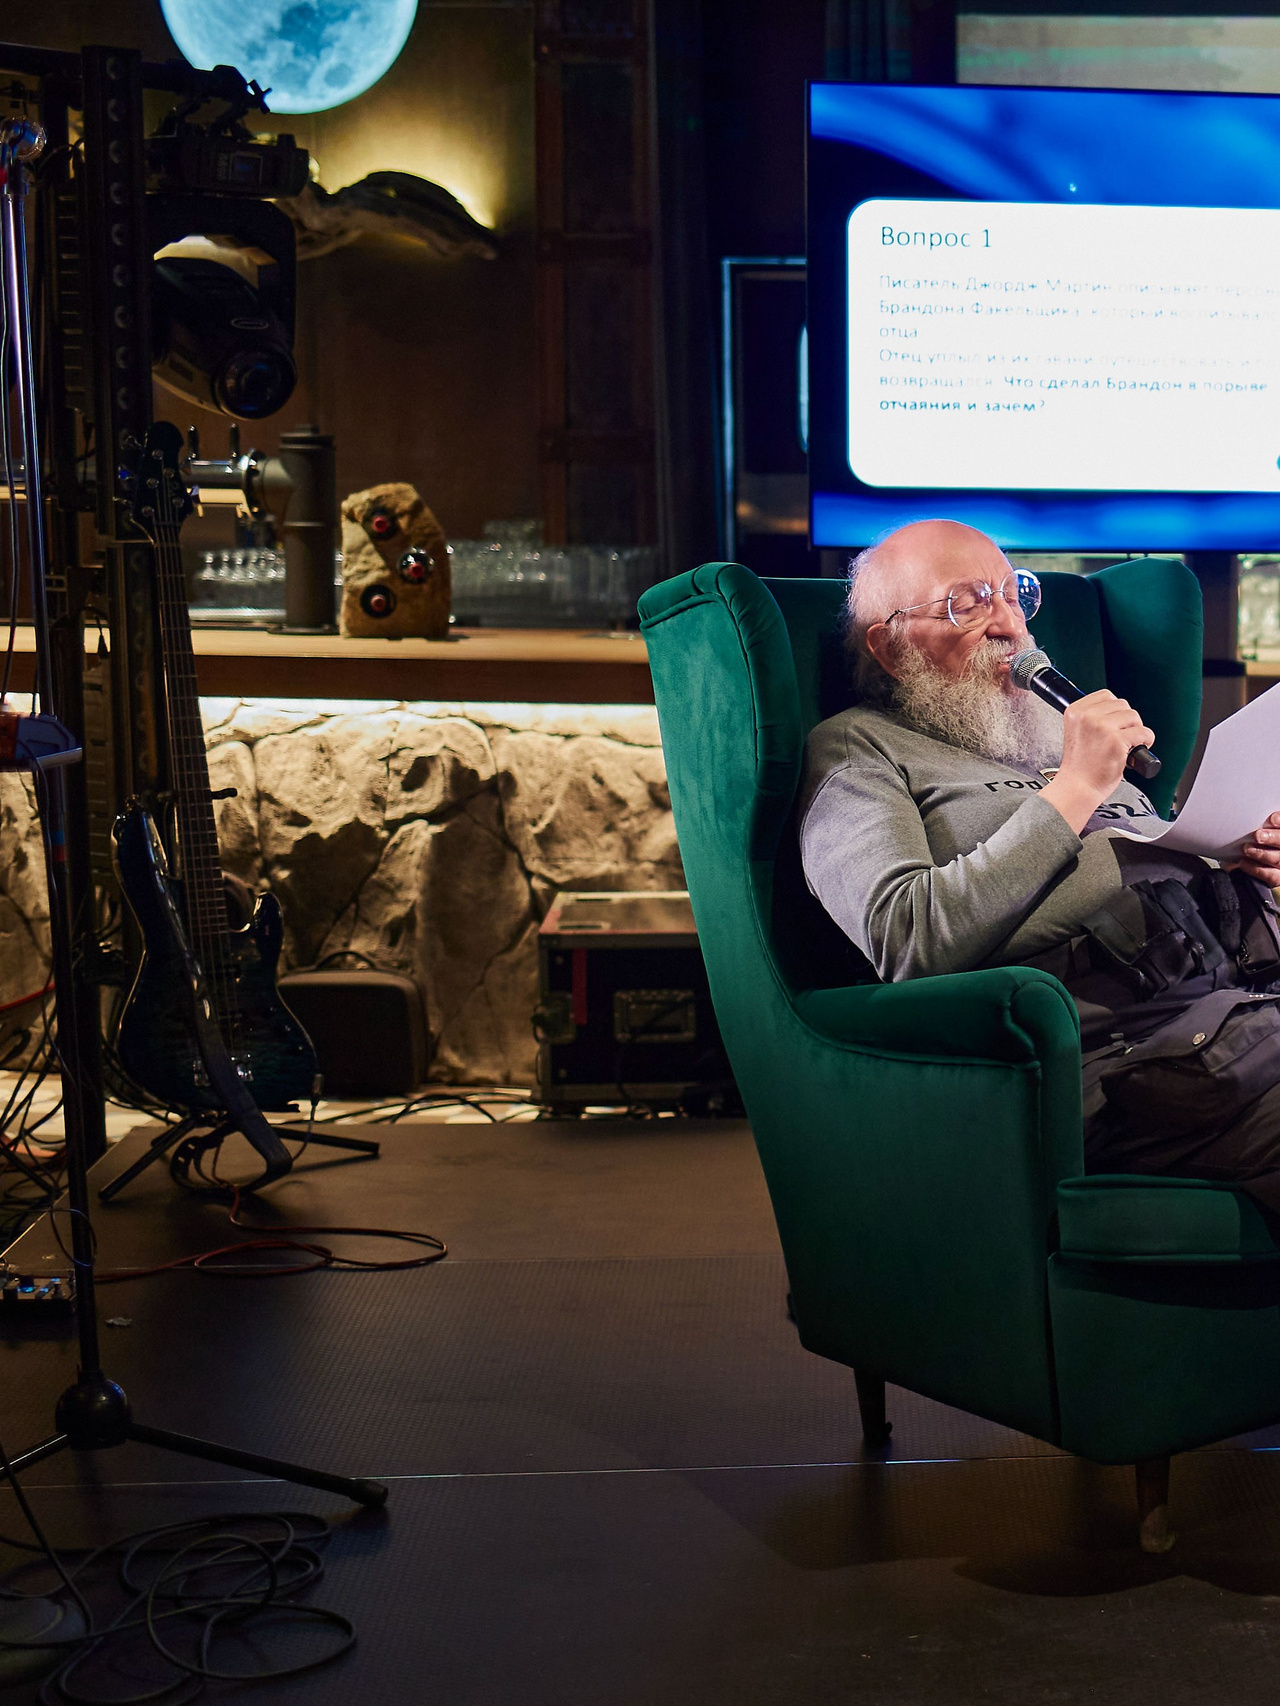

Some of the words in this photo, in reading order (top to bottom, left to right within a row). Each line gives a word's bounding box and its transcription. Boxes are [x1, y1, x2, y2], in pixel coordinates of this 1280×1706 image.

[881, 226, 972, 250] Вопрос
[982, 228, 992, 248] 1
[879, 275, 960, 290] Писатель
[966, 277, 1038, 293] Джордж
[1046, 279, 1112, 293] Мартин
[879, 299, 965, 315] Брандона
[879, 348, 922, 363] Отец
[1012, 355, 1030, 364] их
[1004, 377, 1033, 388] Что
[1039, 379, 1101, 391] сделал
[1106, 378, 1183, 392] Брандон
[1188, 382, 1197, 391] в
[1203, 382, 1268, 393] порыве
[879, 401, 960, 412] отчаяния
[967, 403, 977, 412] и
[985, 400, 1045, 413] зачем?
